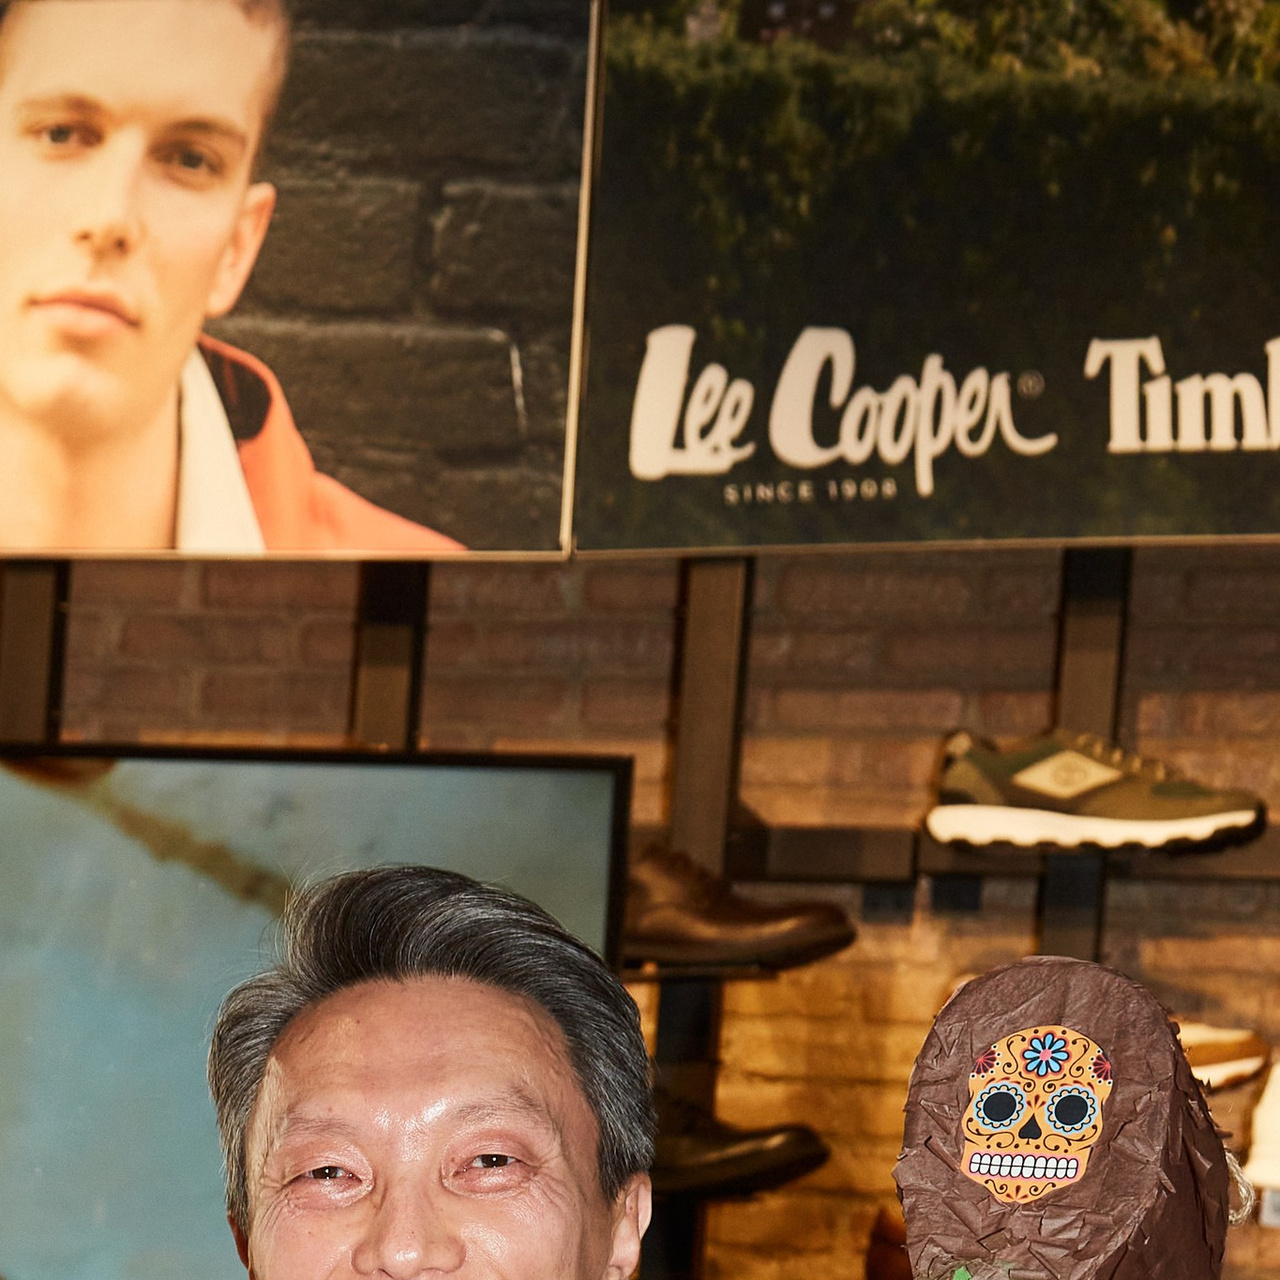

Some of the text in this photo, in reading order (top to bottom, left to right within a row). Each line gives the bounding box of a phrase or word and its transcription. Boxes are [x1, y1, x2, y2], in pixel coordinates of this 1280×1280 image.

[629, 324, 1058, 497] Lee Cooper
[723, 480, 815, 505] SINCE
